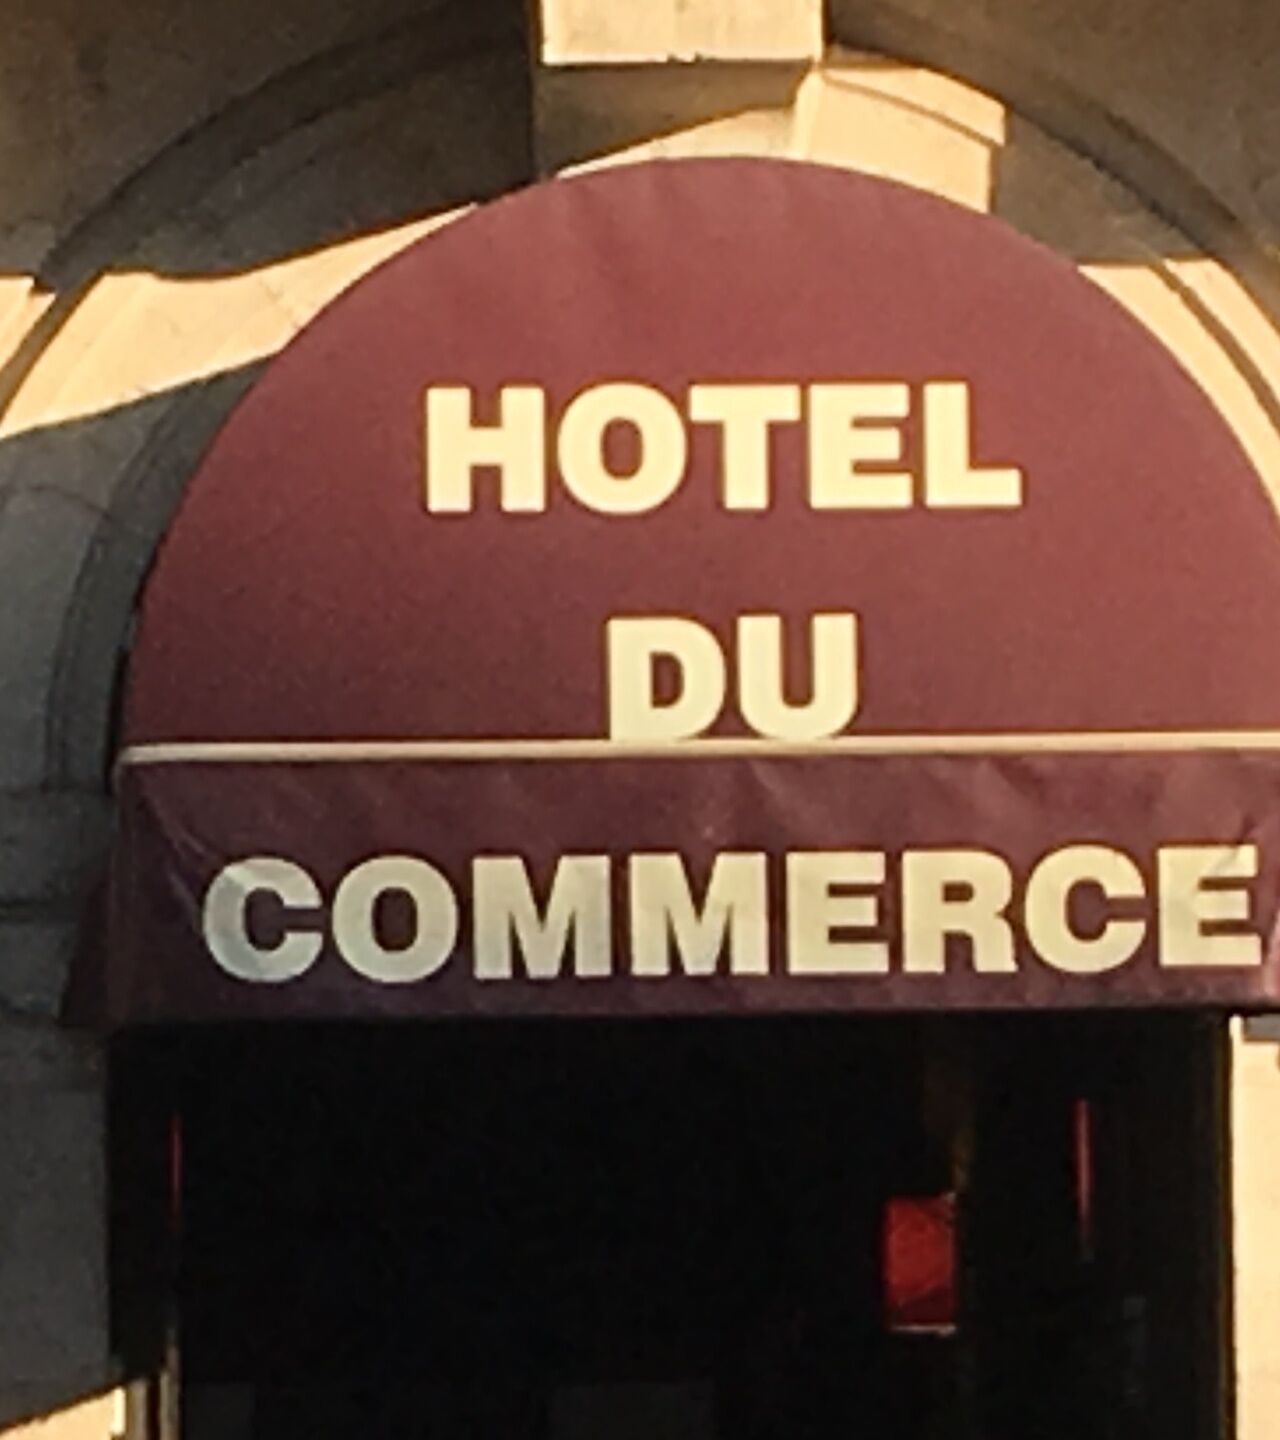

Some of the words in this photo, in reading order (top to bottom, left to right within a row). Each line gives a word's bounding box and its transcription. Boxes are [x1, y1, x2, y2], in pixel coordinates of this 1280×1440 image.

[424, 381, 1024, 516] HOTEL
[606, 613, 861, 742] DU
[202, 846, 1263, 986] COMMERCE
